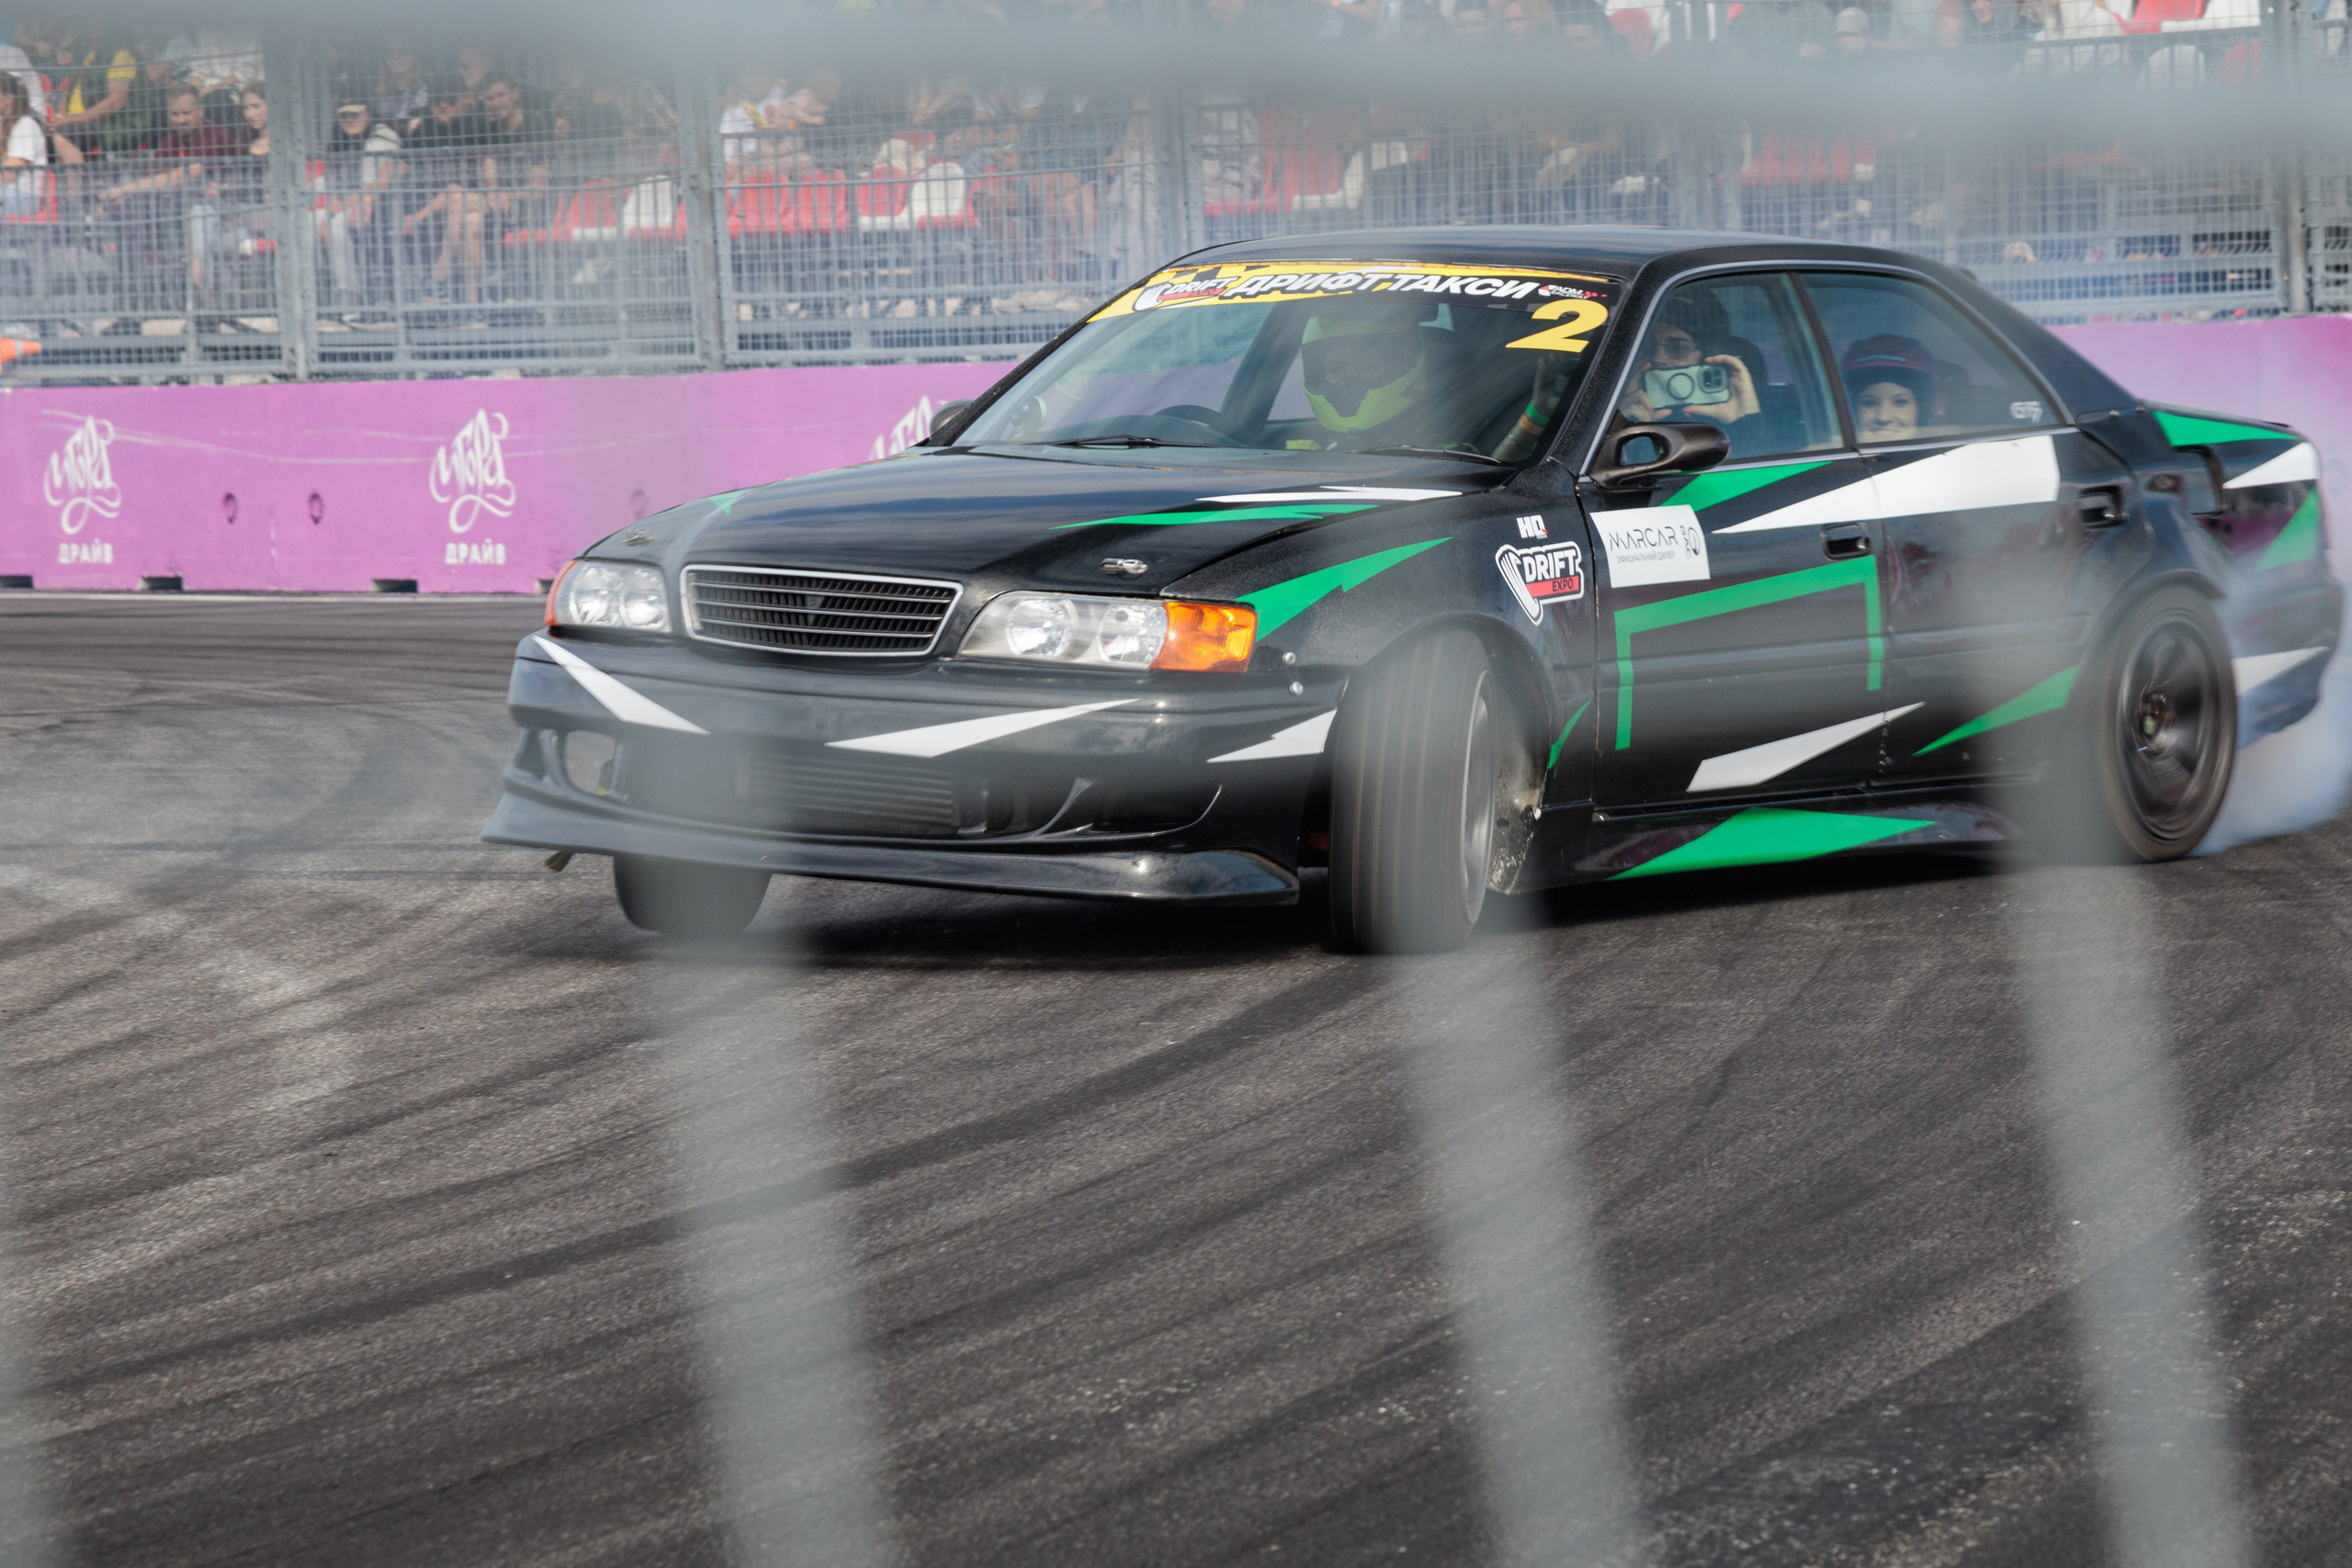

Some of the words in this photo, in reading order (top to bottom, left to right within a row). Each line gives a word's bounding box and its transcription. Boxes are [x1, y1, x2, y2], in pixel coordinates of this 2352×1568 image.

[1163, 276, 1238, 295] DRIFT
[1505, 299, 1608, 353] 2
[1517, 514, 1548, 539] HQ
[1609, 526, 1679, 550] MARCAR
[58, 538, 113, 564] ДРАЙВ
[445, 538, 505, 565] ДРАЙВ
[1522, 549, 1577, 582] DRIFT
[1552, 578, 1574, 592] EXPO
